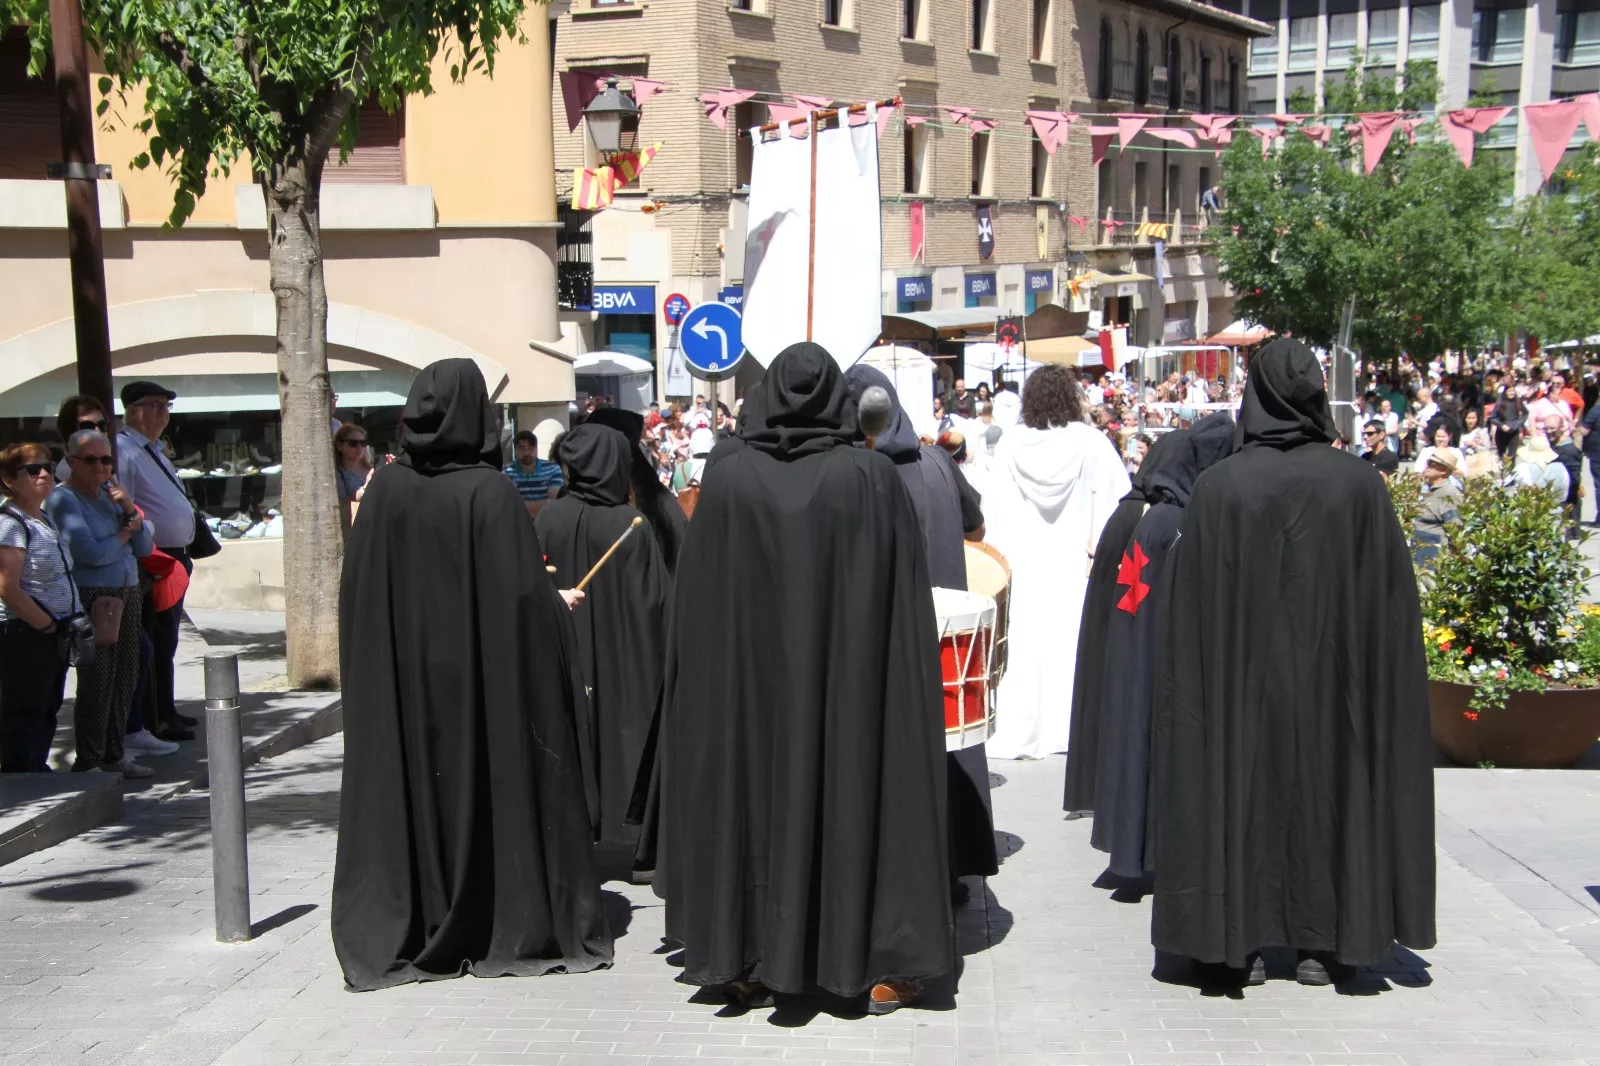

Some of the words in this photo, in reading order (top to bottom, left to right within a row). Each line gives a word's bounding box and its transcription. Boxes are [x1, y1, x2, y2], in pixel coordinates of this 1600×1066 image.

[972, 278, 990, 293] BBVA
[1032, 273, 1048, 288] BBVA
[905, 282, 925, 296] BBVA
[593, 291, 636, 308] BBVA
